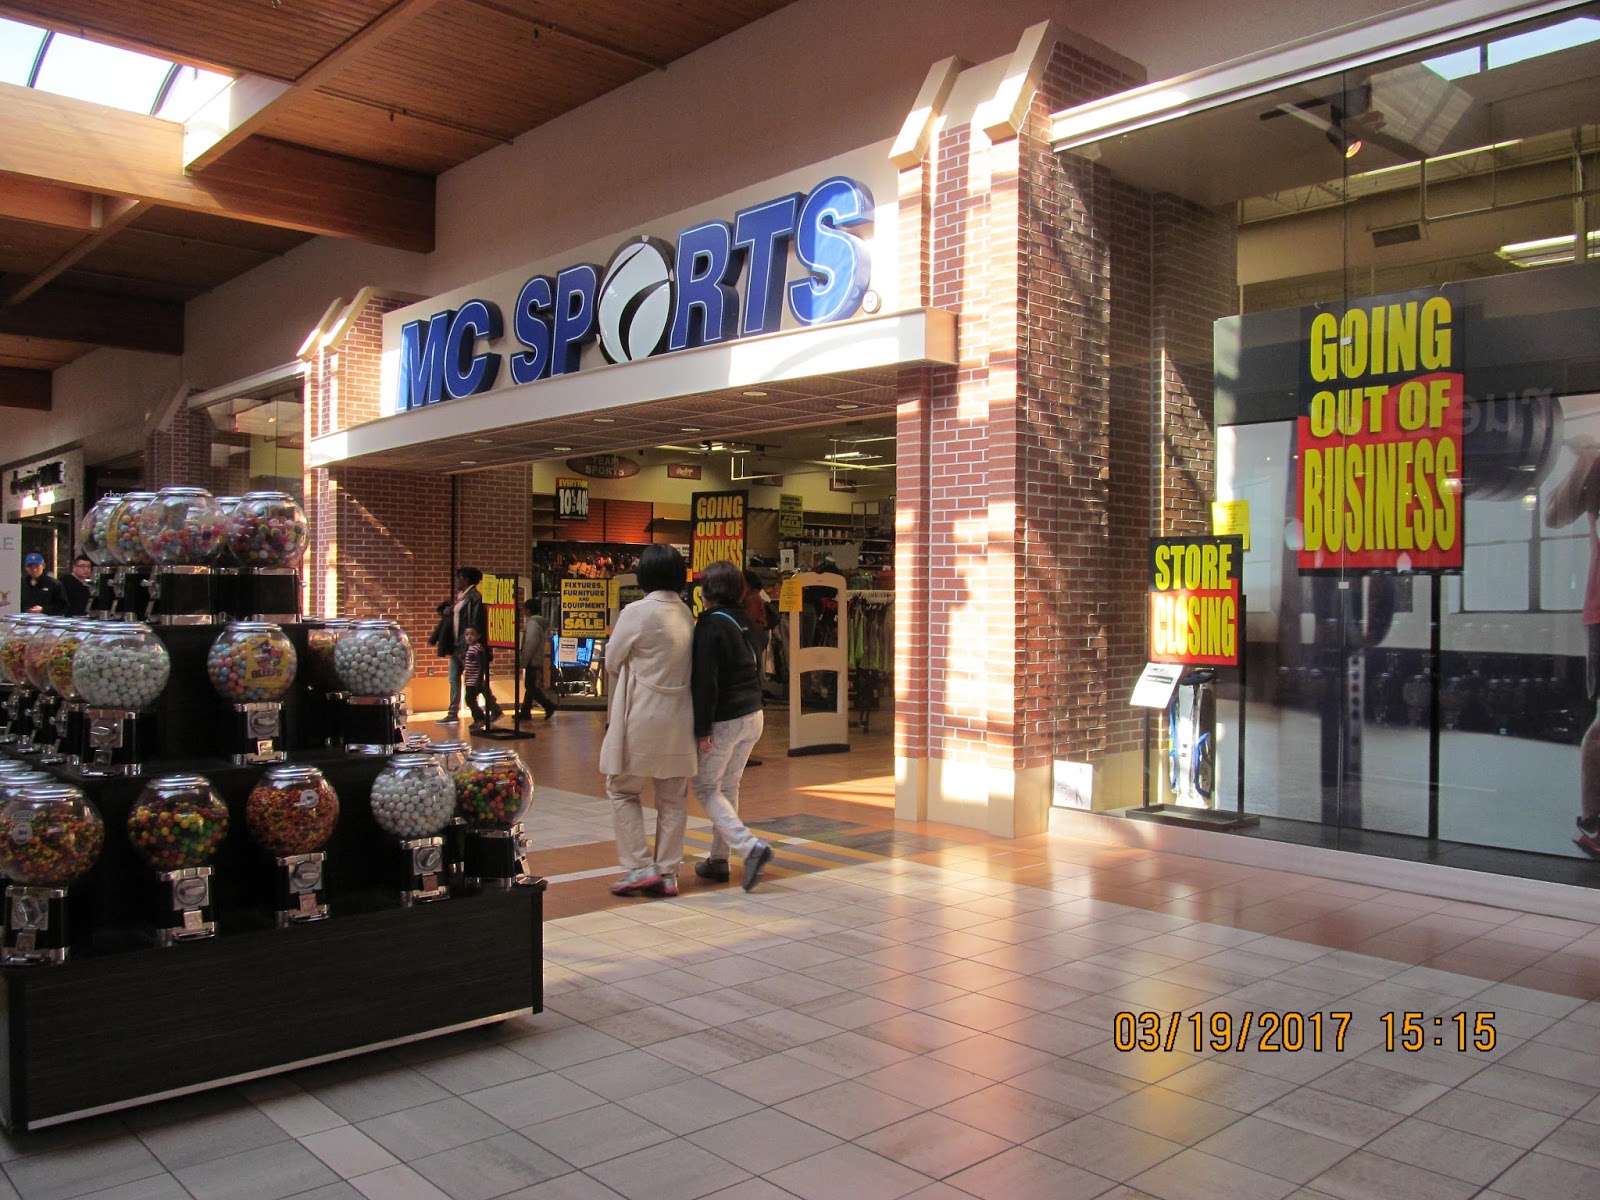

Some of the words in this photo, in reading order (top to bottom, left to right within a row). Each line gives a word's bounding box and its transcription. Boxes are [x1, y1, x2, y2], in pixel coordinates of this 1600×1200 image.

[394, 298, 503, 413] MC
[511, 176, 876, 385] SPORTS
[1310, 296, 1452, 383] GOING
[1310, 385, 1389, 438] OUT
[1398, 379, 1452, 431] OF
[585, 465, 625, 476] SPORTS
[592, 455, 619, 466] TEAM
[696, 495, 744, 520] GOING
[1304, 436, 1457, 553] BUSINESS
[696, 521, 723, 537] OUT
[725, 519, 744, 537] OF
[692, 538, 744, 573] BUSINESS
[1155, 543, 1233, 591] STORE
[493, 578, 515, 605] TORE
[563, 589, 605, 597] FURNITURE
[564, 582, 604, 590] FIXTURES,
[488, 607, 516, 643] CLOSING
[564, 618, 604, 630] SALE
[569, 611, 598, 619] FOR
[1153, 594, 1236, 658] CLOSING
